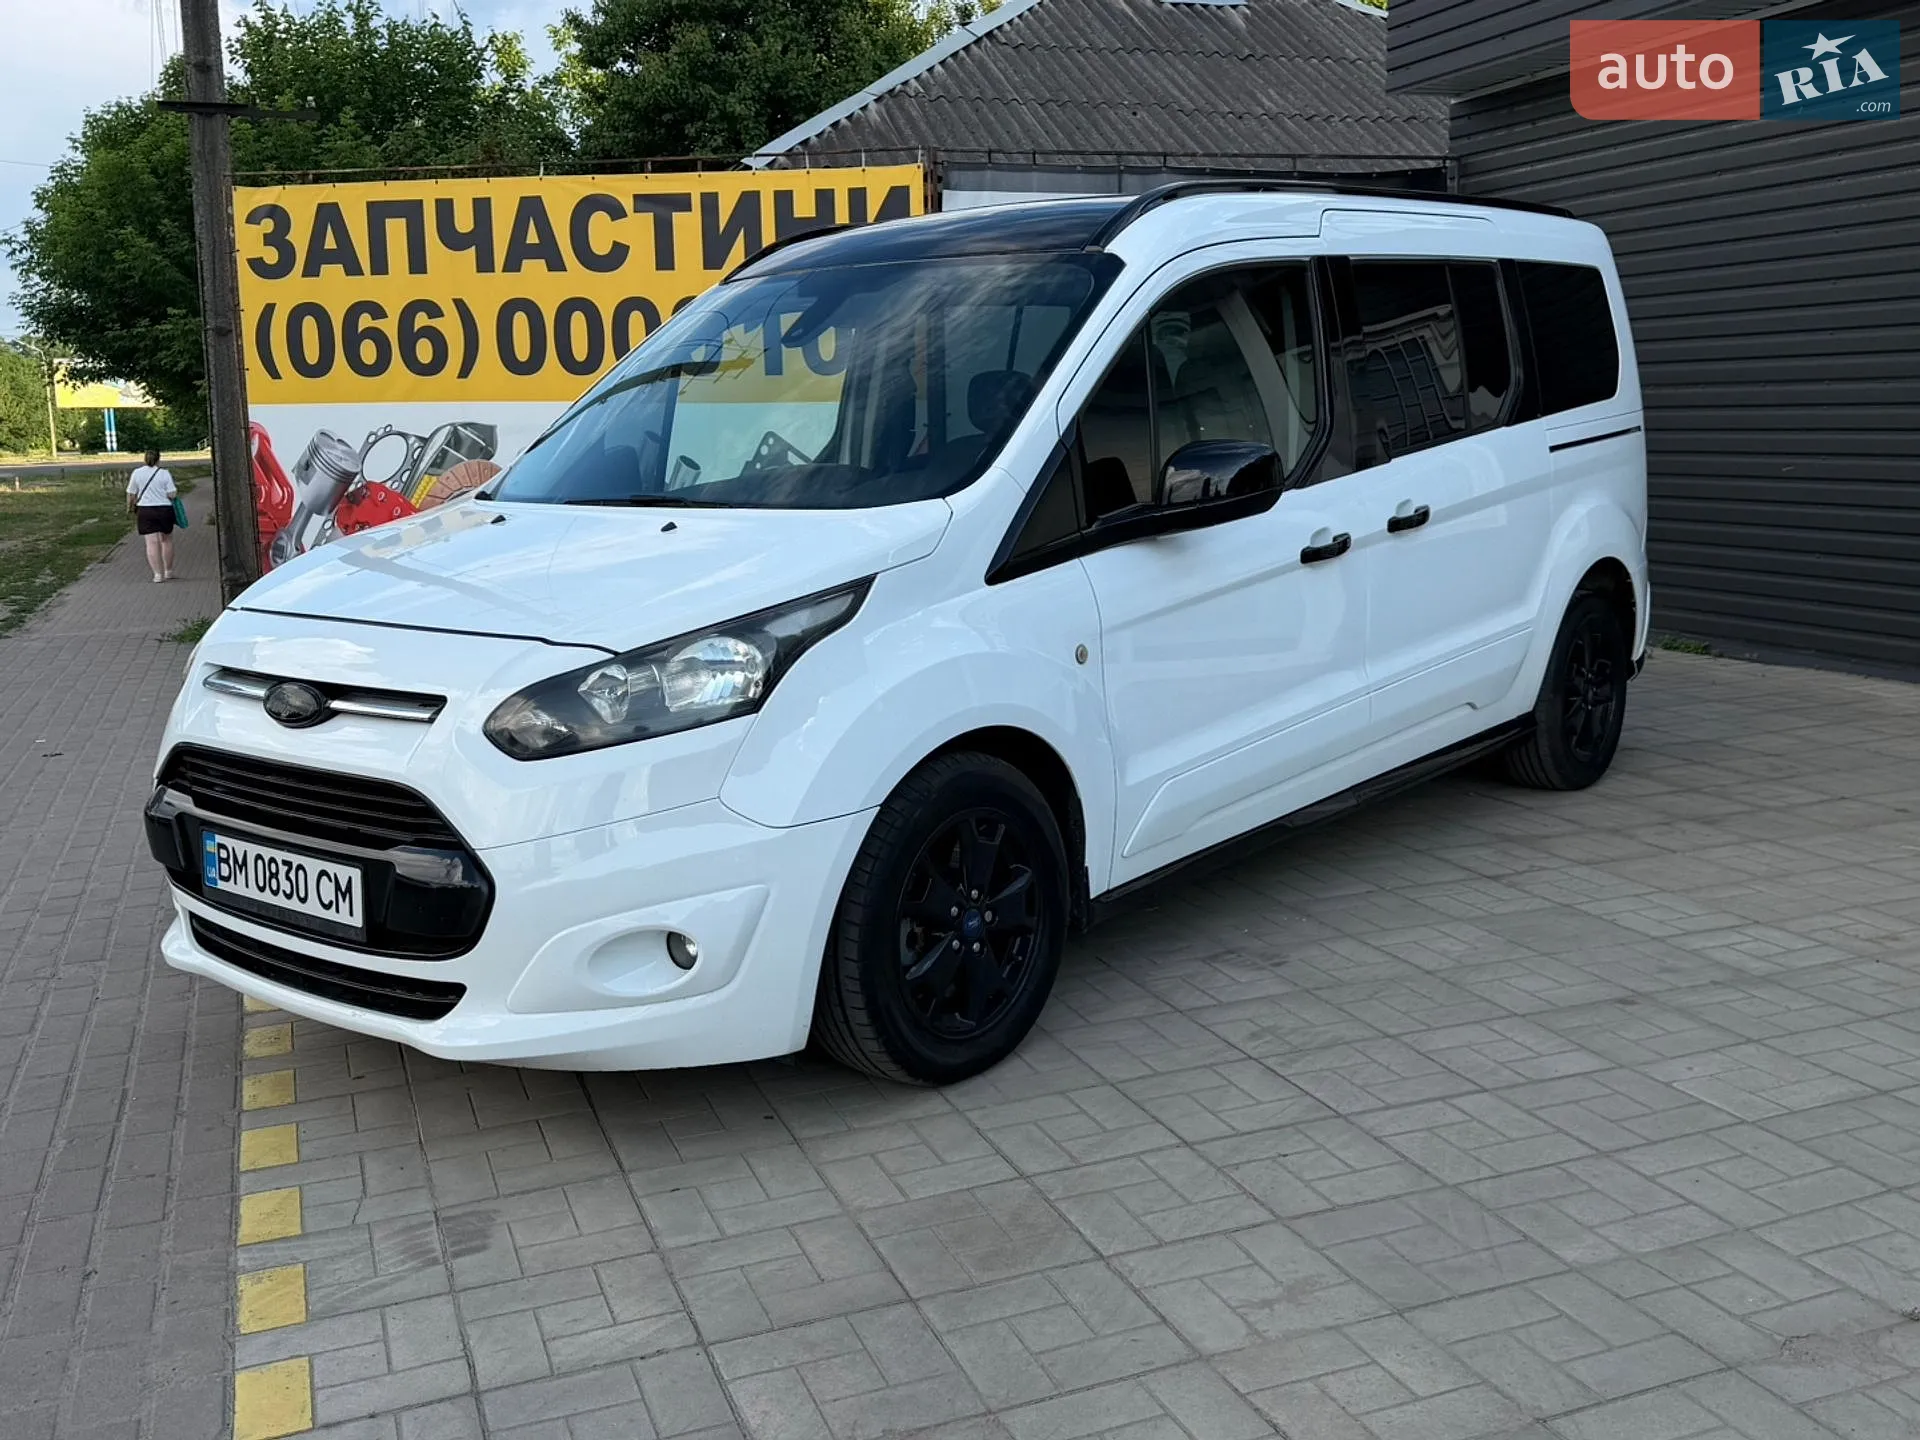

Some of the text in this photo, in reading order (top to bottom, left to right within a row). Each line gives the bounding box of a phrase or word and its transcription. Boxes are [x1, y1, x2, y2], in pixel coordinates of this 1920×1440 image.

[216, 842, 354, 917] BM 0830 CM
